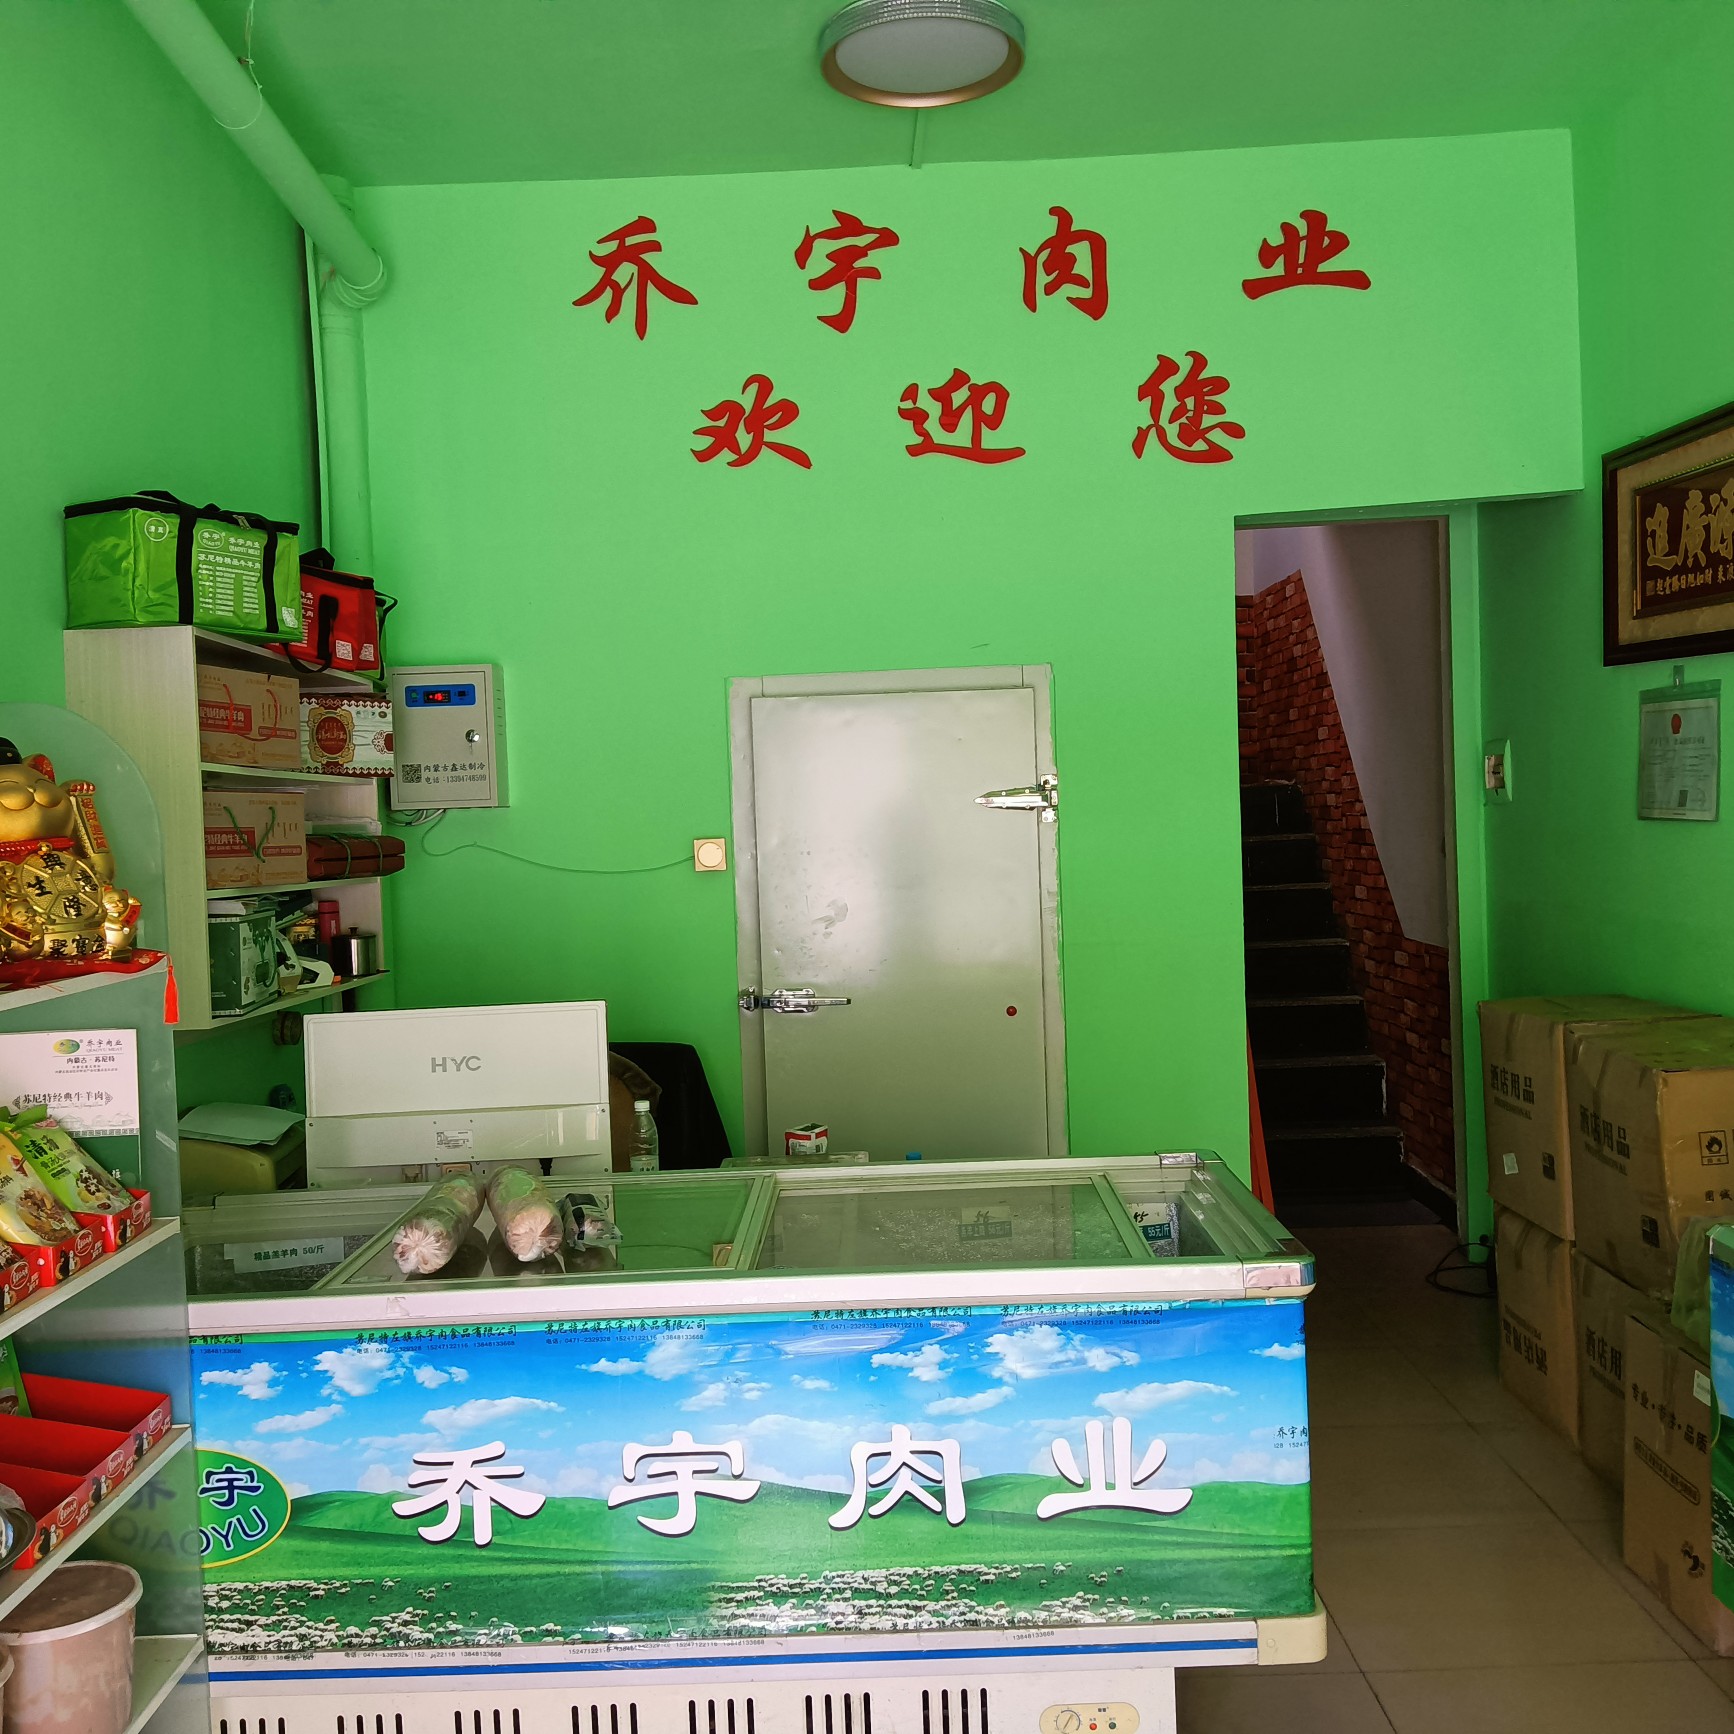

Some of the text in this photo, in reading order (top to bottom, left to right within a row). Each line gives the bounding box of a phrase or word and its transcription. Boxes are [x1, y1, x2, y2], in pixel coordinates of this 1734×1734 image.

[572, 205, 1371, 341] 乔宇肉业
[690, 350, 1246, 470] 欢迎您
[431, 1056, 482, 1073] HYC
[392, 1416, 1194, 1548] 乔宇肉业
